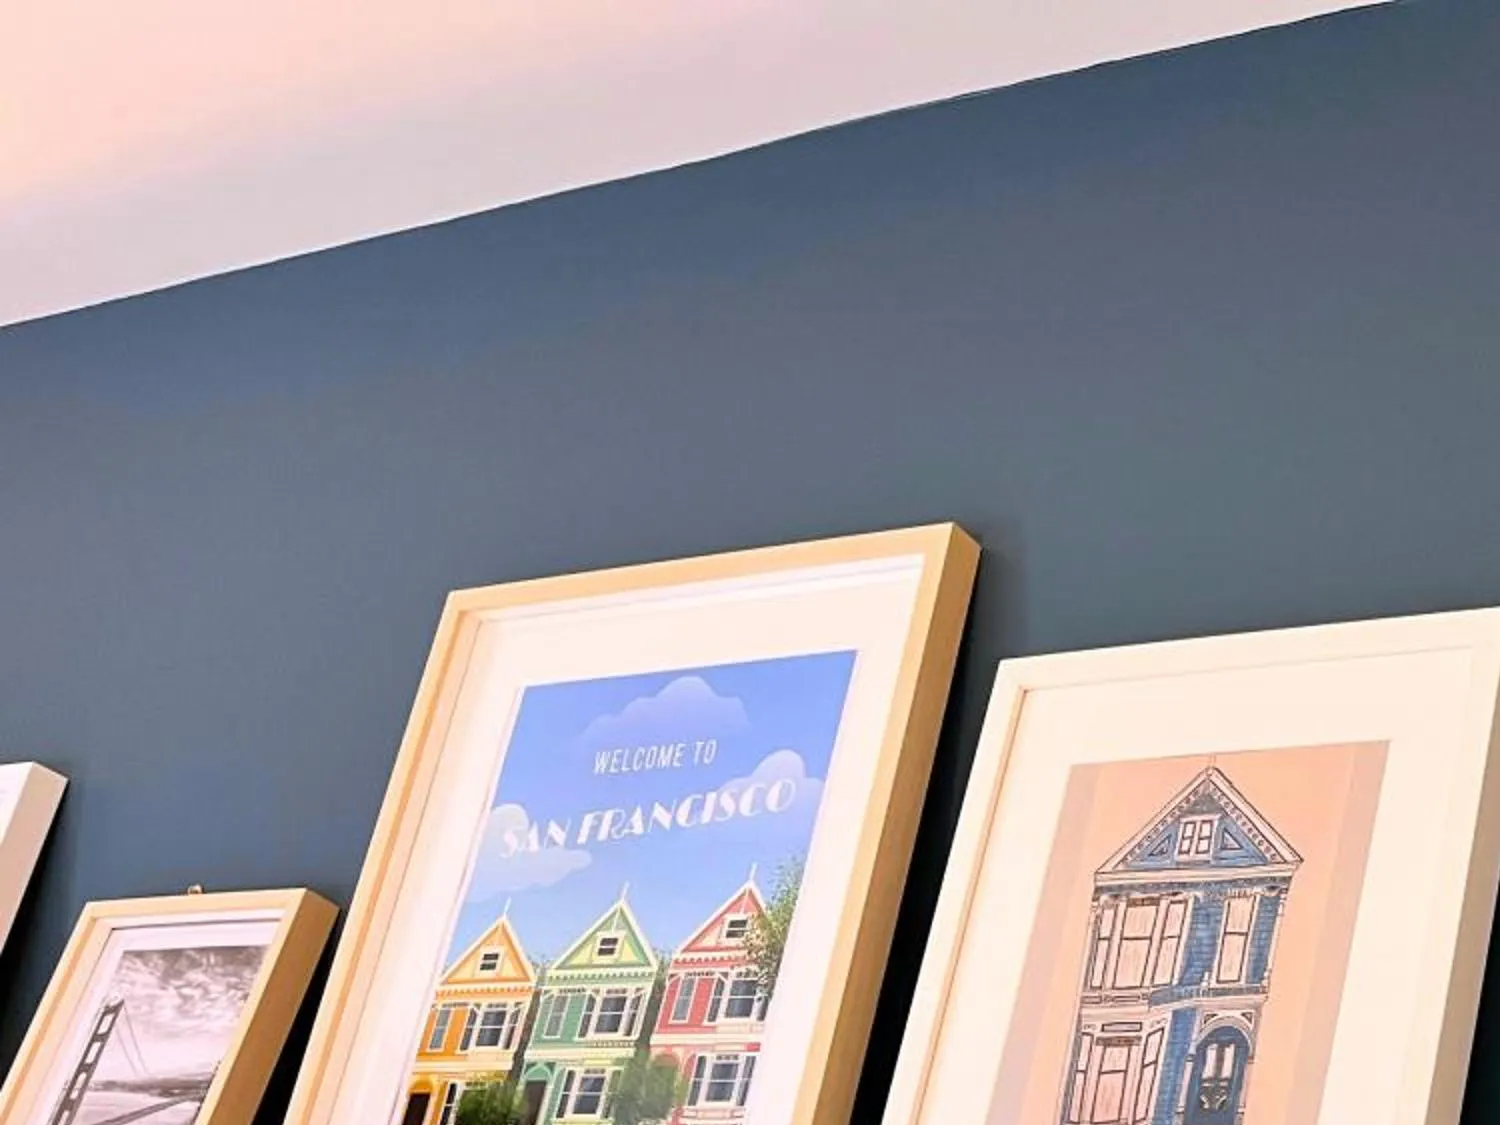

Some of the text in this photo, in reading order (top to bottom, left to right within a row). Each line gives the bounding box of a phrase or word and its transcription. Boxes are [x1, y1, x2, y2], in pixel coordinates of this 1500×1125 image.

[594, 739, 718, 775] WELCOME TO
[500, 777, 797, 858] SAN FRANCISCO
